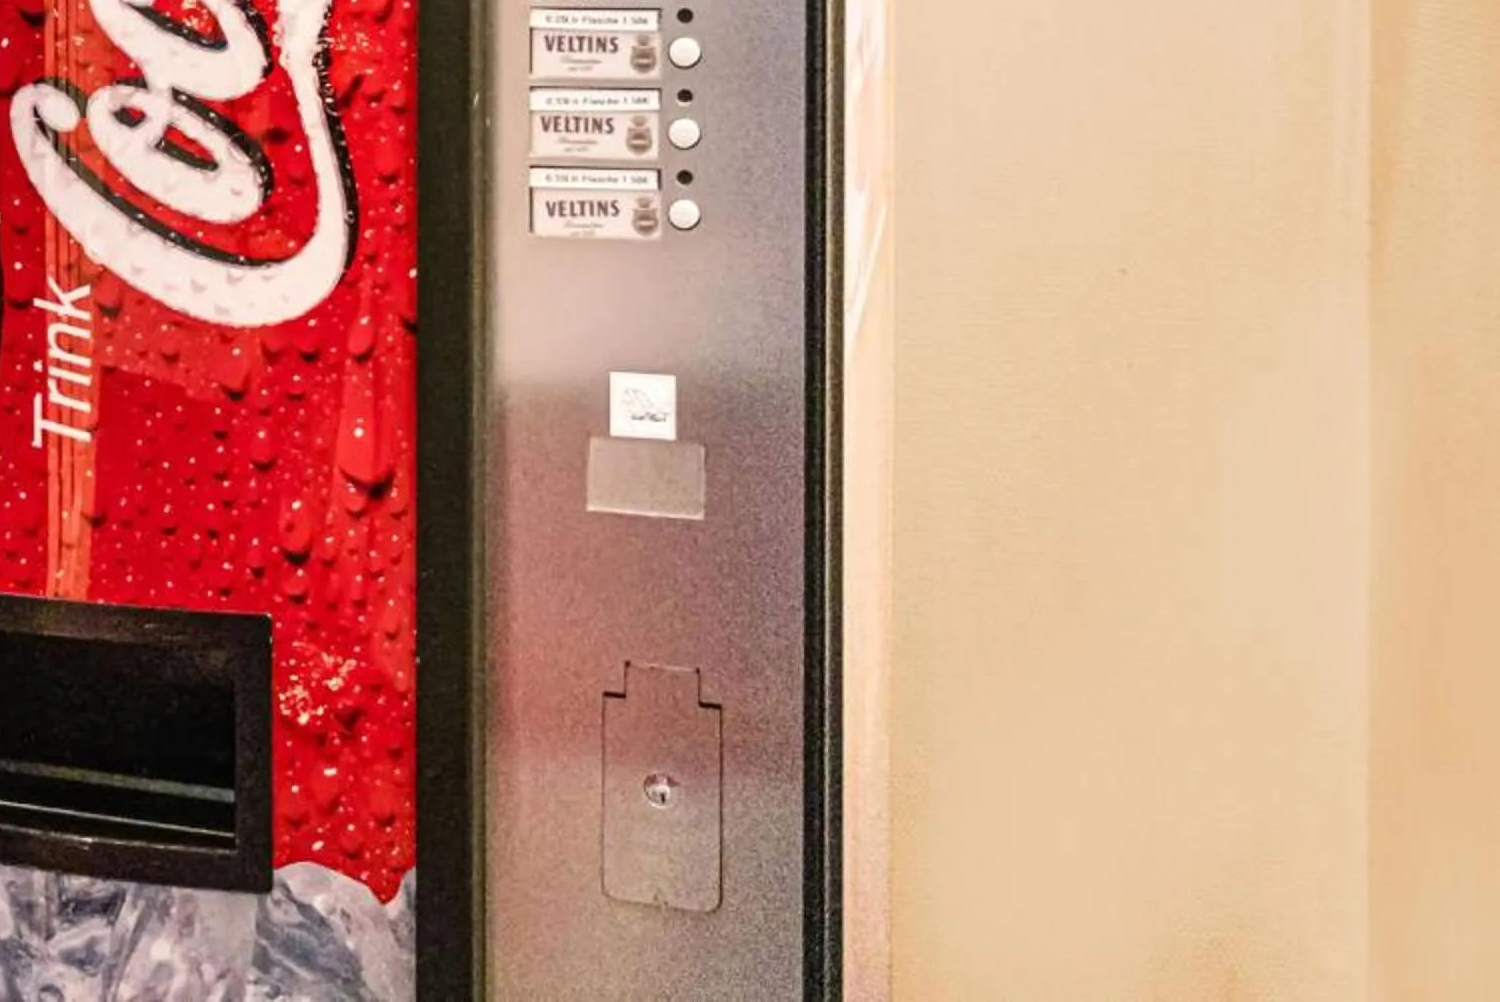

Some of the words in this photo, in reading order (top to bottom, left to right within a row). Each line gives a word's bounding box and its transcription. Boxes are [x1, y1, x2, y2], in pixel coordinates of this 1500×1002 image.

[544, 35, 620, 54] VELTINS
[540, 115, 615, 135] VELTINS
[545, 199, 620, 218] VELTINS
[32, 278, 94, 450] Trink
